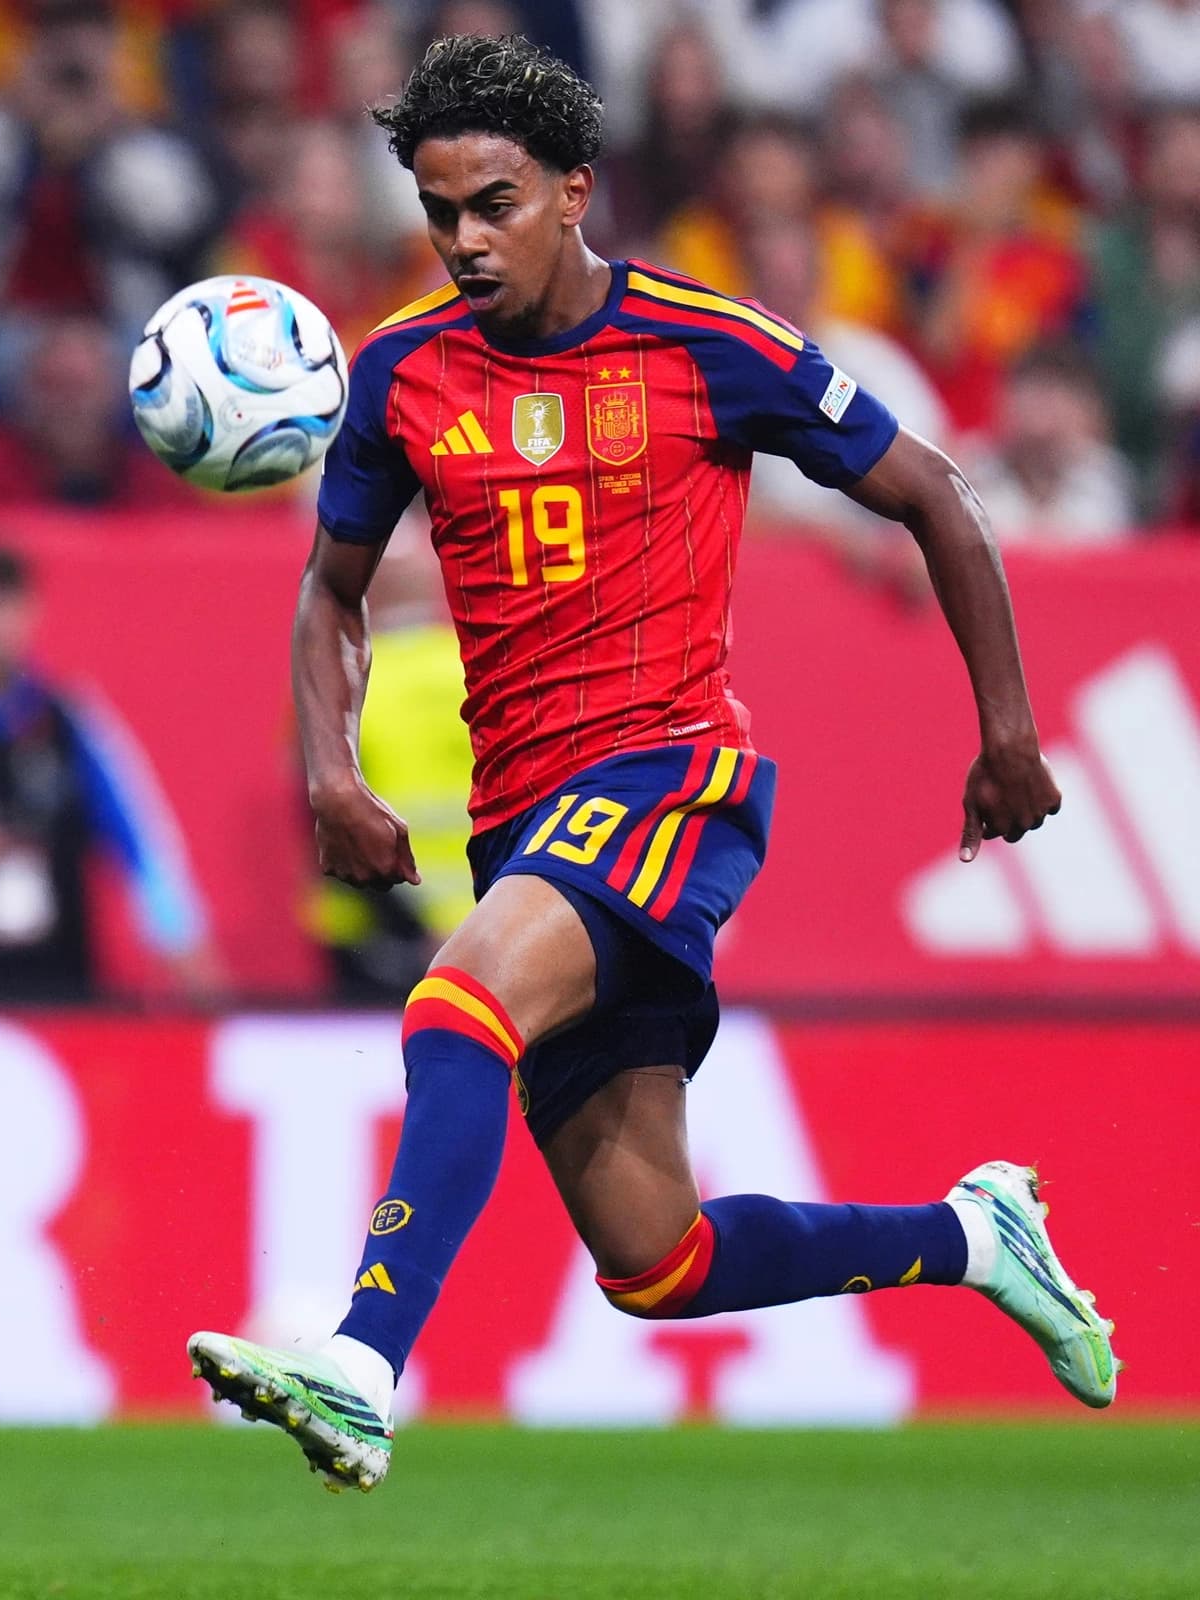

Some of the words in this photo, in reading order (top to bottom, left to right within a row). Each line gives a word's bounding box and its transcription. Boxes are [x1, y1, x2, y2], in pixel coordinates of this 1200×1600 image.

[528, 438, 550, 447] FIFA
[499, 485, 586, 585] 19
[523, 794, 629, 865] 19
[378, 1207, 401, 1219] RF
[375, 1216, 397, 1229] EF
